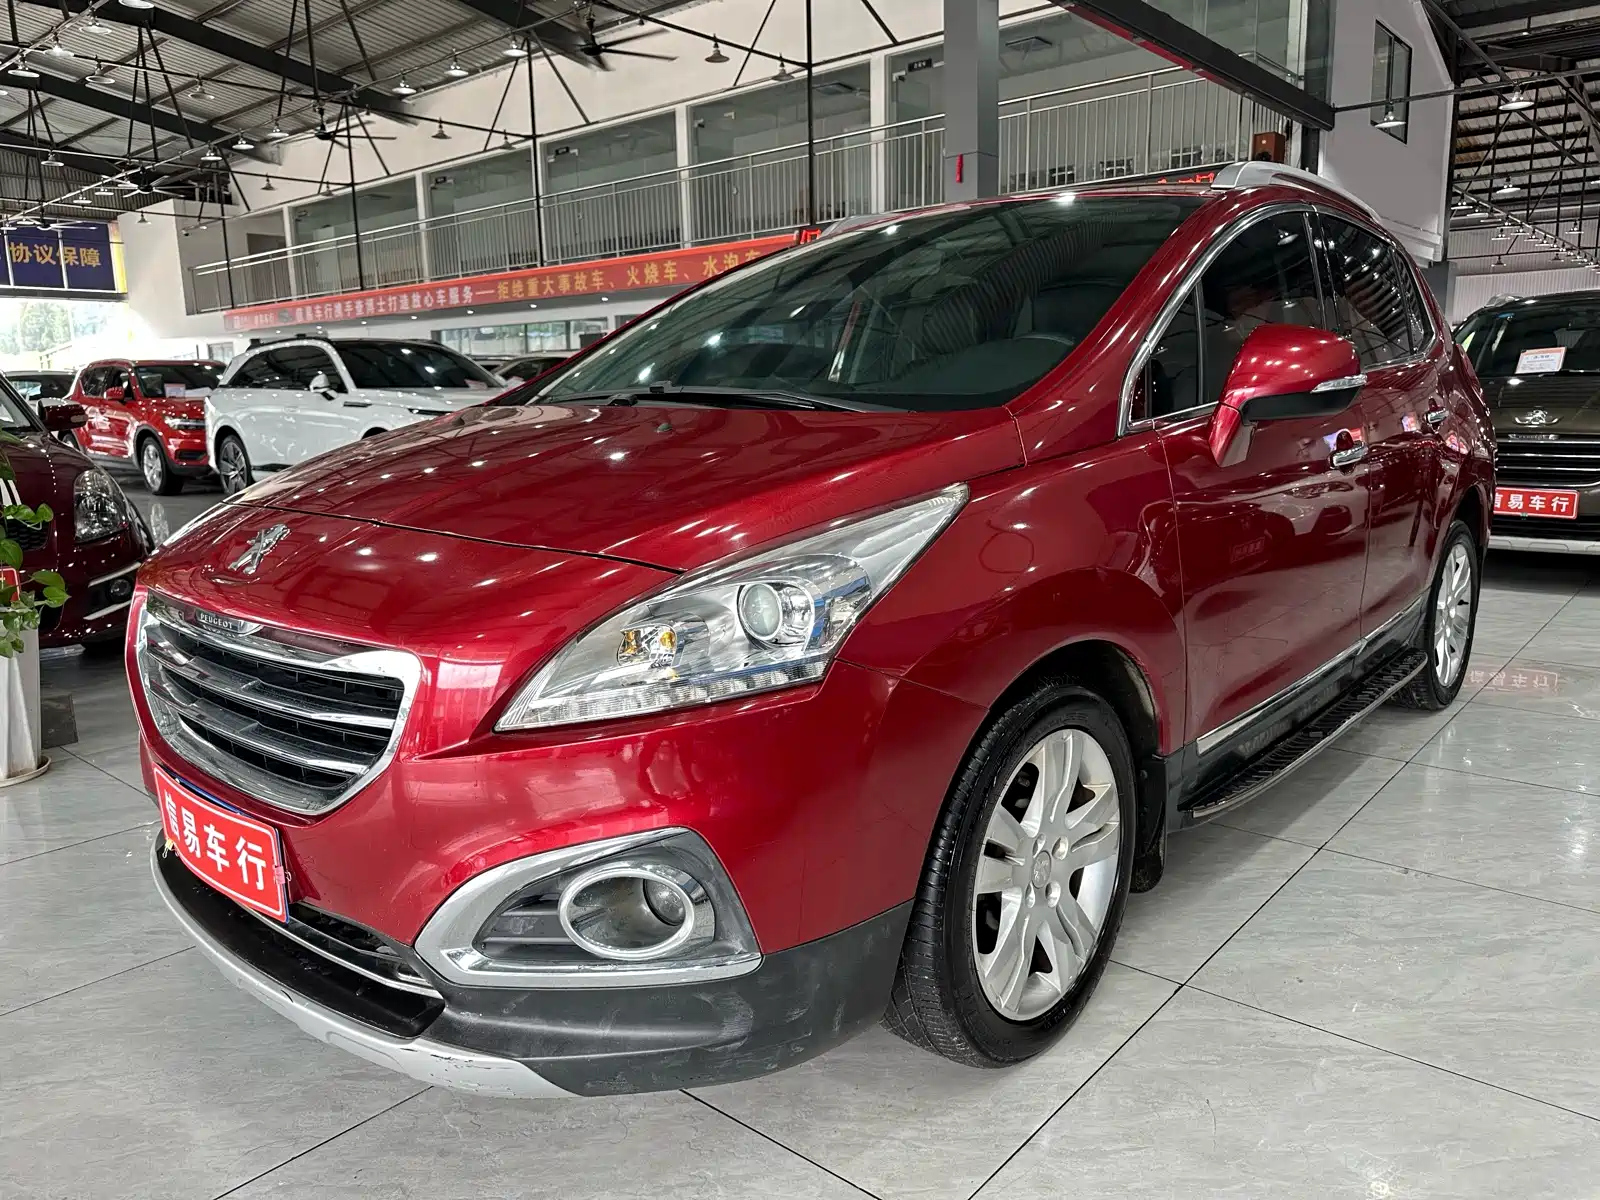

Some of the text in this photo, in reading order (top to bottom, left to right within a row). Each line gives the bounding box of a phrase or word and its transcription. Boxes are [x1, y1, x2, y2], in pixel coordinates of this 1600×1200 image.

[9, 241, 102, 268] 协议保障
[200, 612, 233, 628] PEUGEOT
[163, 791, 267, 891] 信易车行
